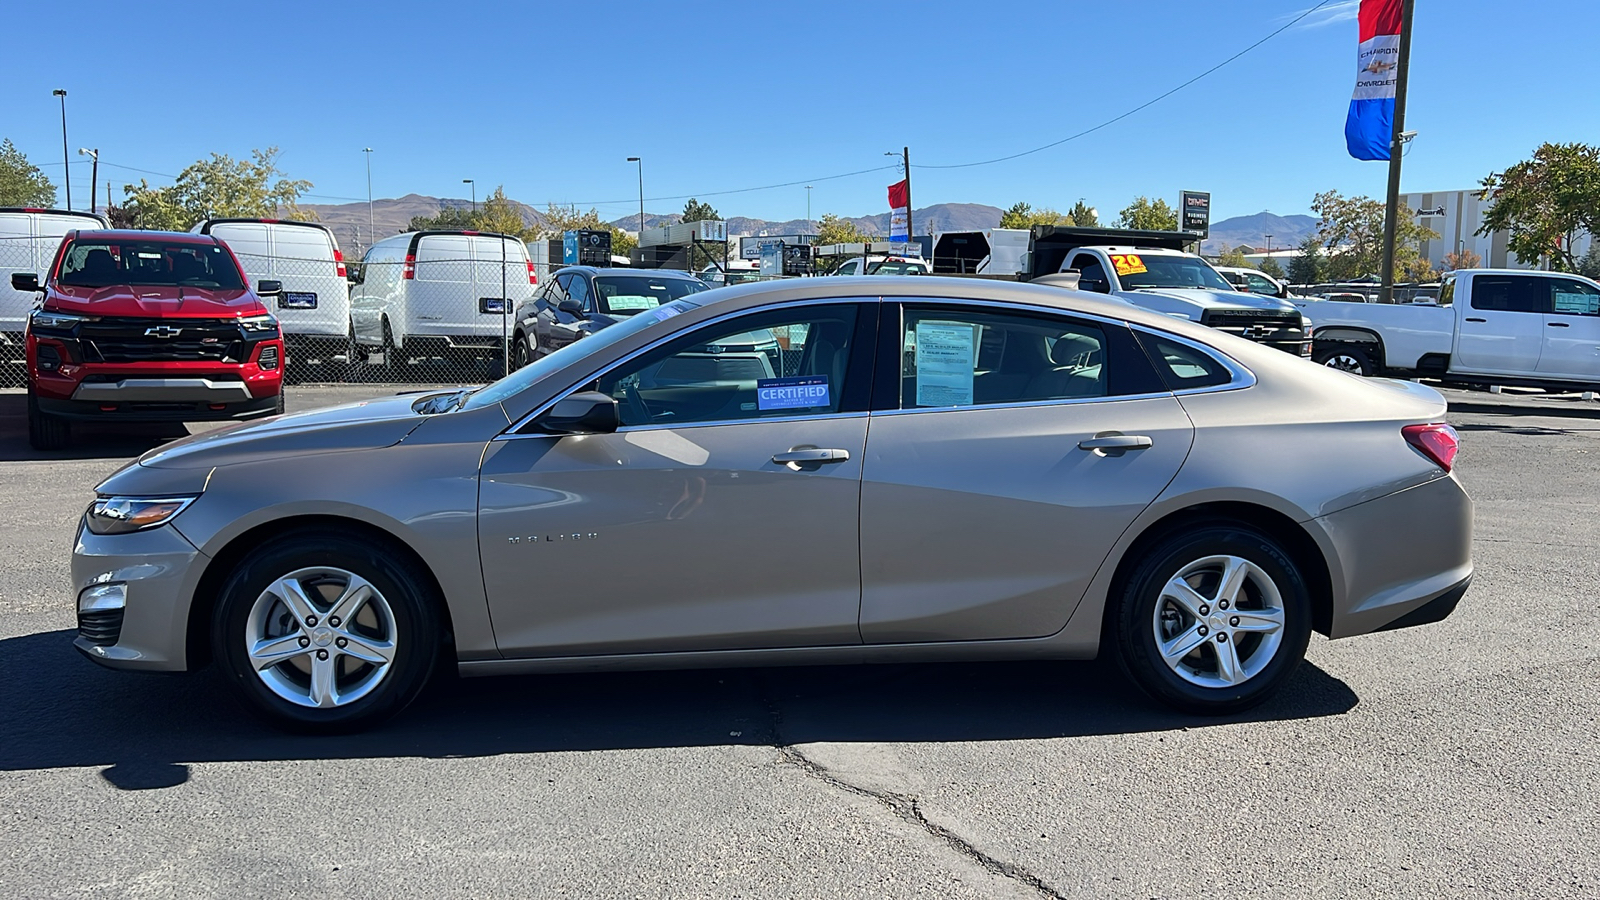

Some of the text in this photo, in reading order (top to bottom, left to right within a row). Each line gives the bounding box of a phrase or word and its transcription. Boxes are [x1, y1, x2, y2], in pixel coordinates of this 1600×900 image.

[1361, 48, 1397, 58] CHAMPION
[1357, 79, 1397, 87] CHEVROLET
[1187, 197, 1208, 206] GMC
[1112, 254, 1140, 268] 20
[761, 386, 826, 400] CERTIFIED
[508, 532, 598, 544] MALIBU
